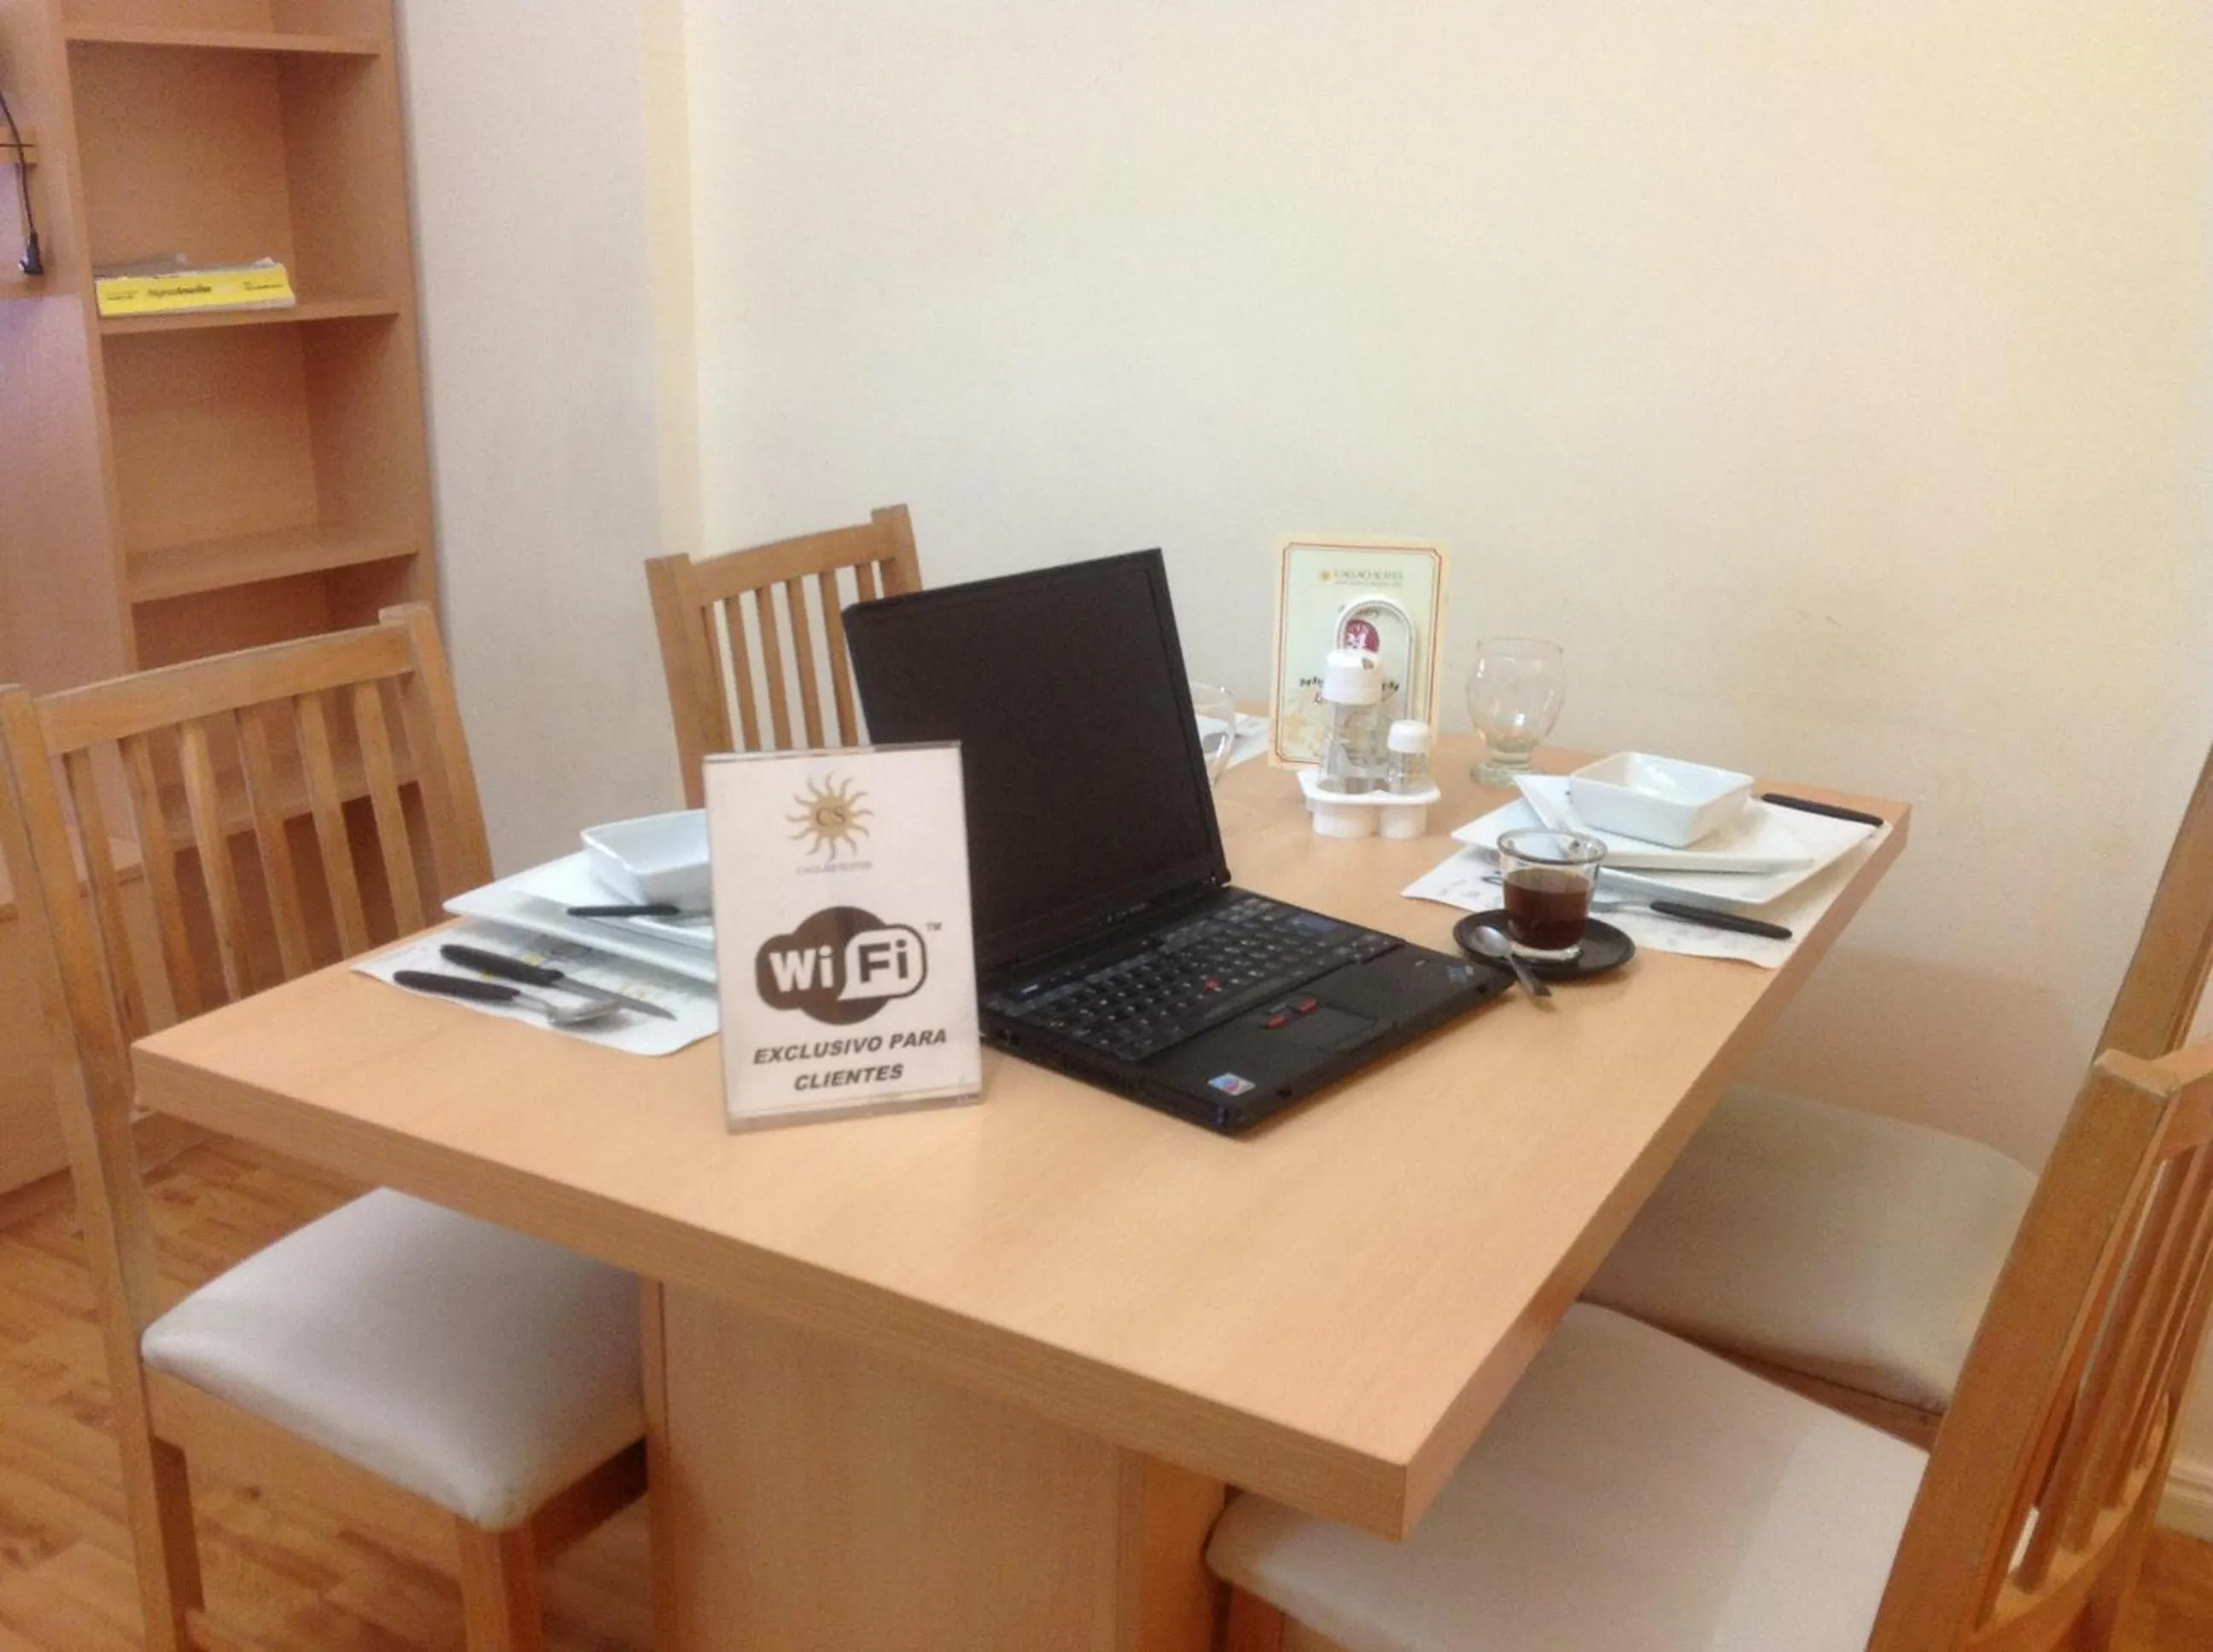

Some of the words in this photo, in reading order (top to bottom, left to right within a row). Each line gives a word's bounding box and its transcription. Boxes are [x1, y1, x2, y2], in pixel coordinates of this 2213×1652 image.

[752, 1035, 883, 1065] EXCLUSIVO
[888, 1028, 947, 1050] PARA
[792, 1064, 904, 1091] CLIENTES
